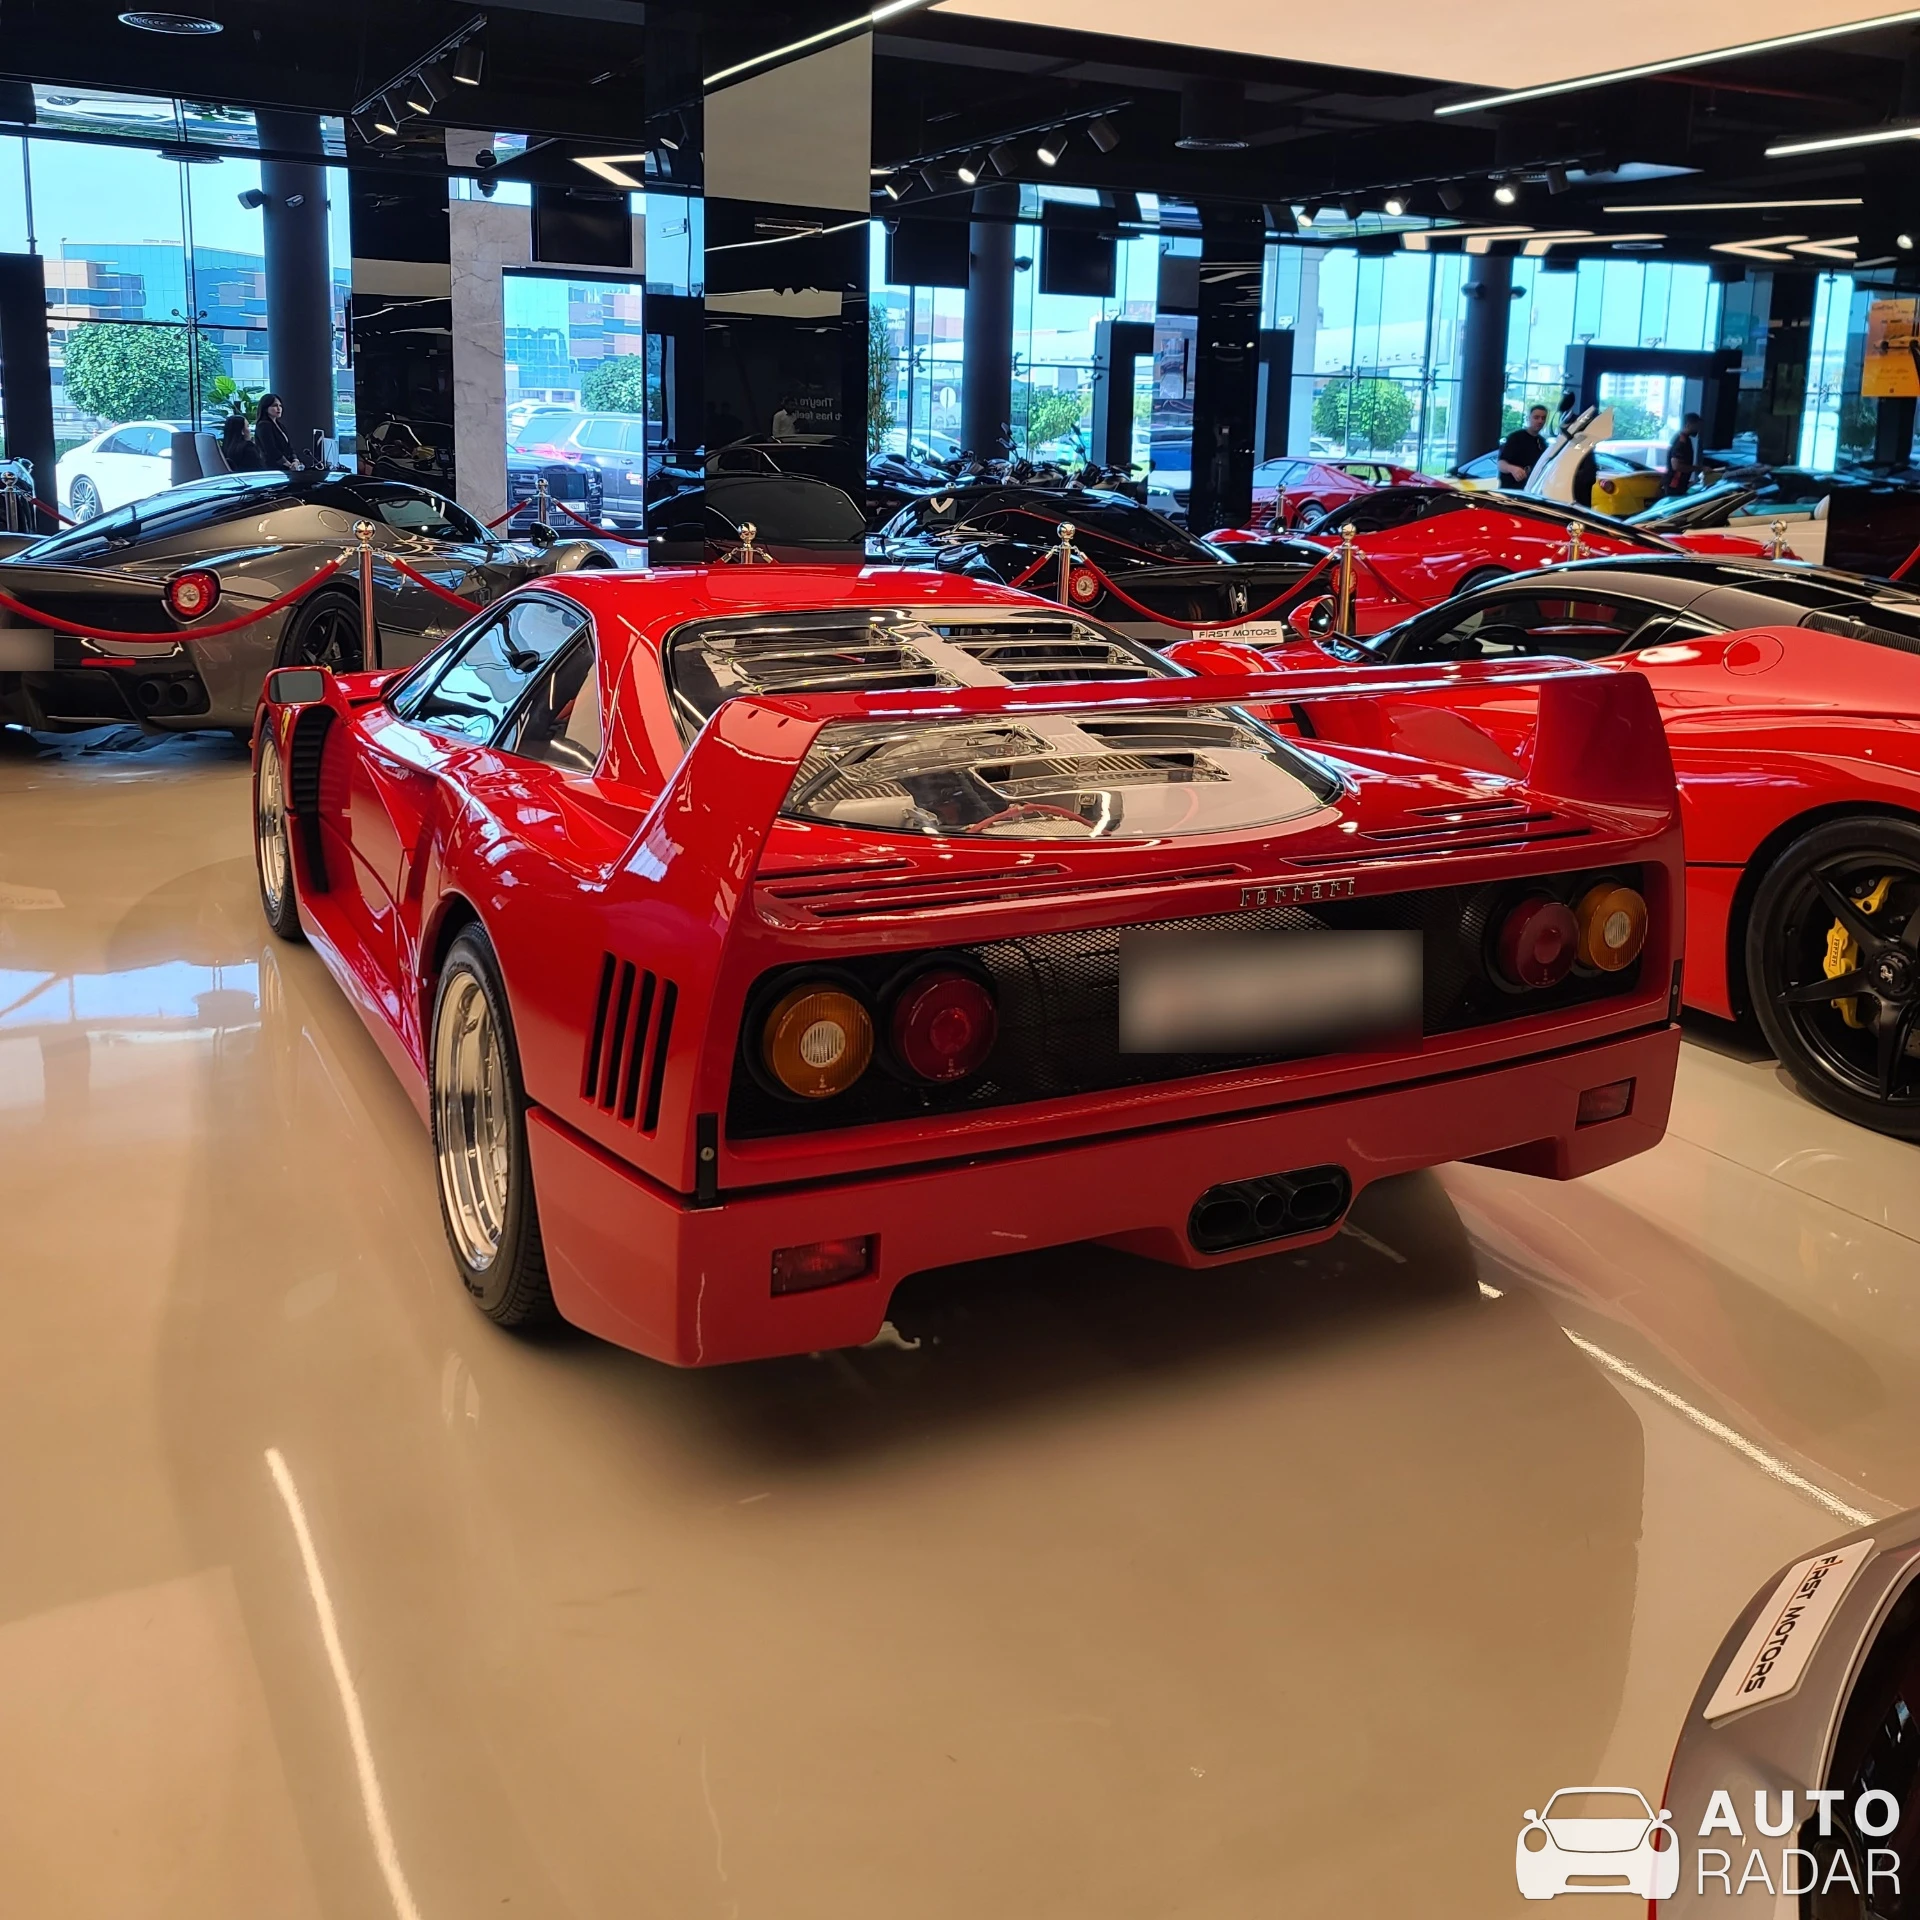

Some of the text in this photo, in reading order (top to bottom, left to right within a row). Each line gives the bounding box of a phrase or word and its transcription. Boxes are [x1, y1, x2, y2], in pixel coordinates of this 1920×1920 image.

[1199, 628, 1278, 639] FIRST MOTORS
[1239, 876, 1356, 907] Ferrari
[1743, 1554, 1844, 1693] FIRST MOTORS
